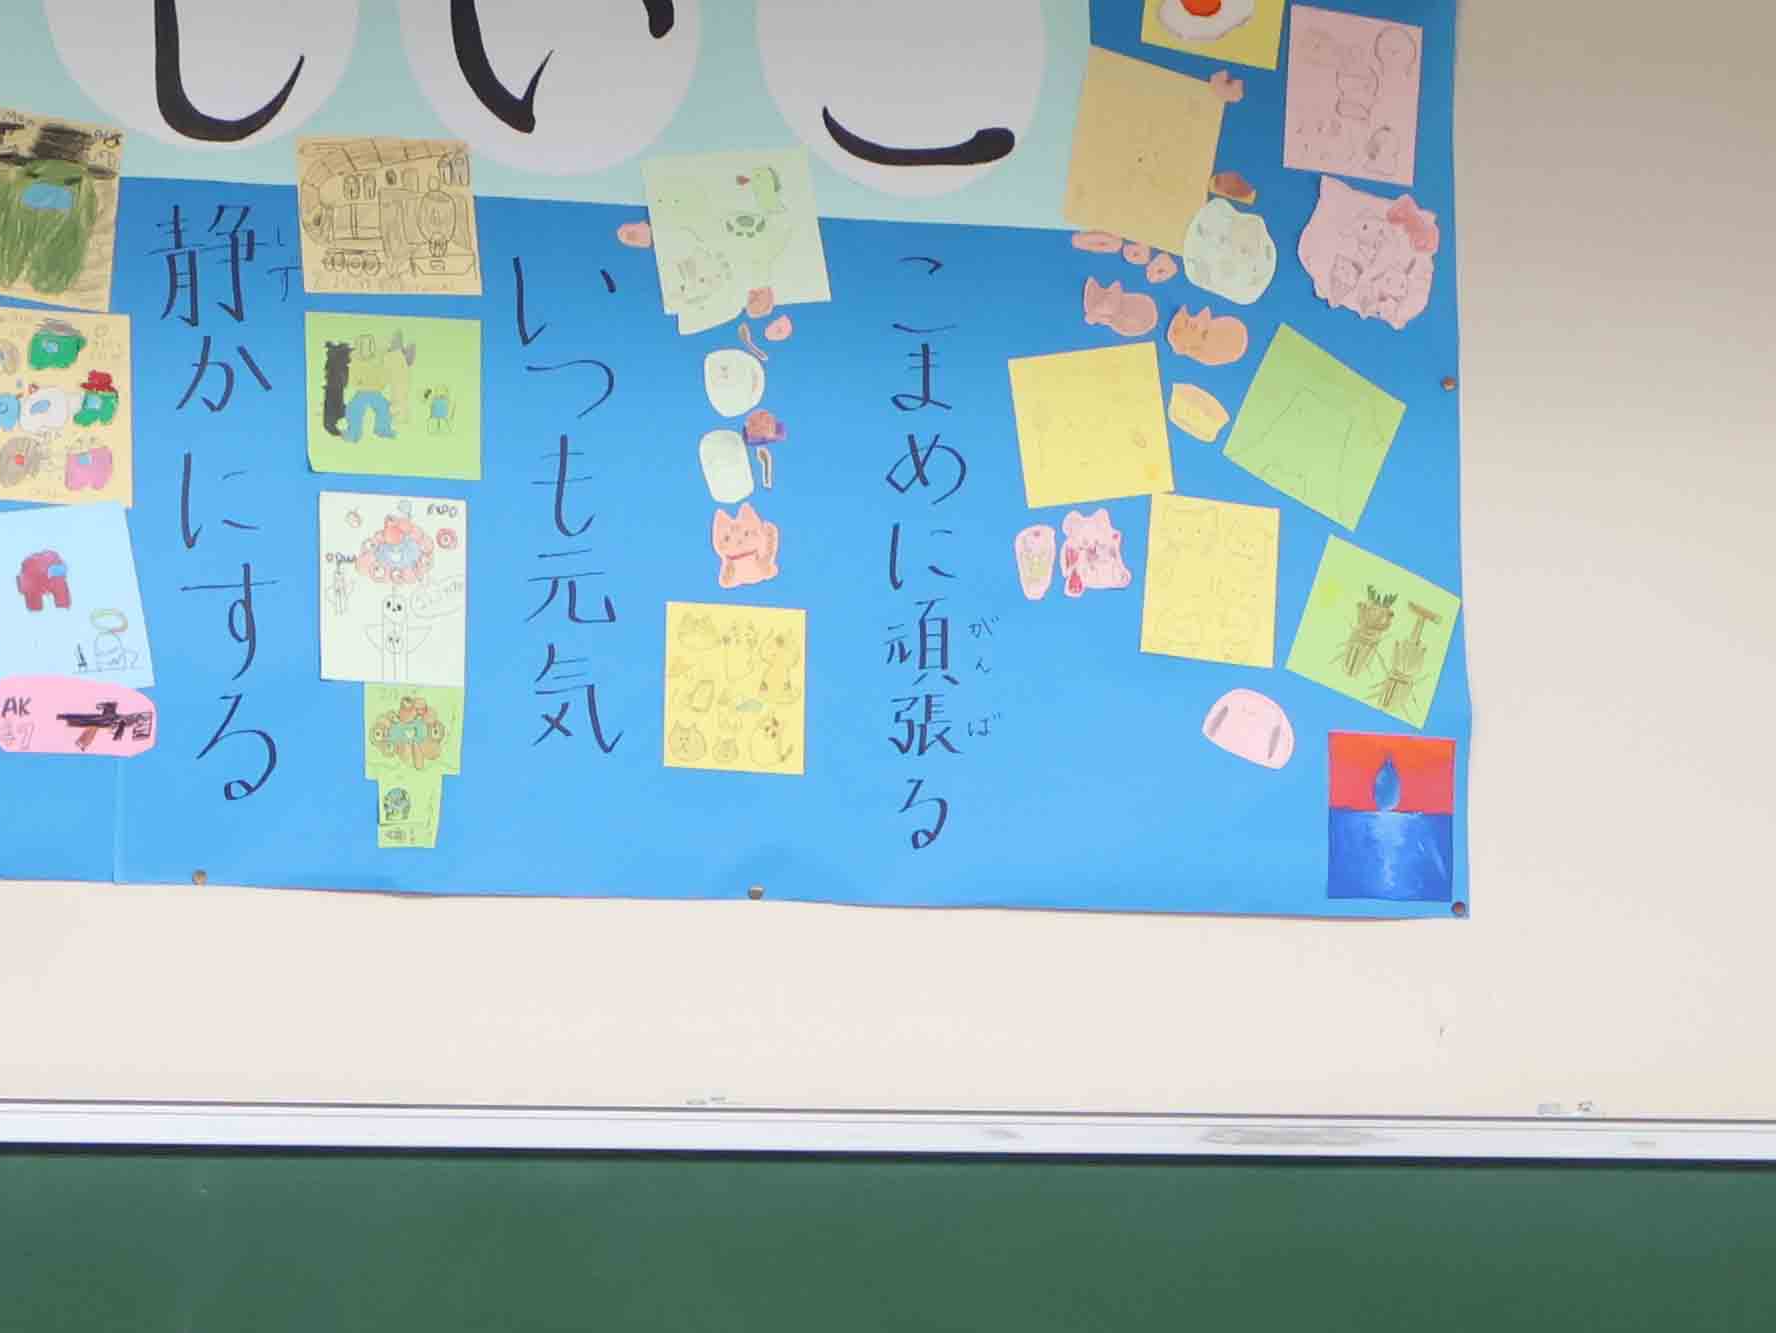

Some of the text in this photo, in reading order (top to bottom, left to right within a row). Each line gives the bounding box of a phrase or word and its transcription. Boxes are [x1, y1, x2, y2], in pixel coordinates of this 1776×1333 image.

[2, 697, 31, 716] AK
[148, 204, 277, 801] 静かにする
[514, 257, 622, 755] いつも元気
[887, 257, 966, 850] こまめに頑張る
